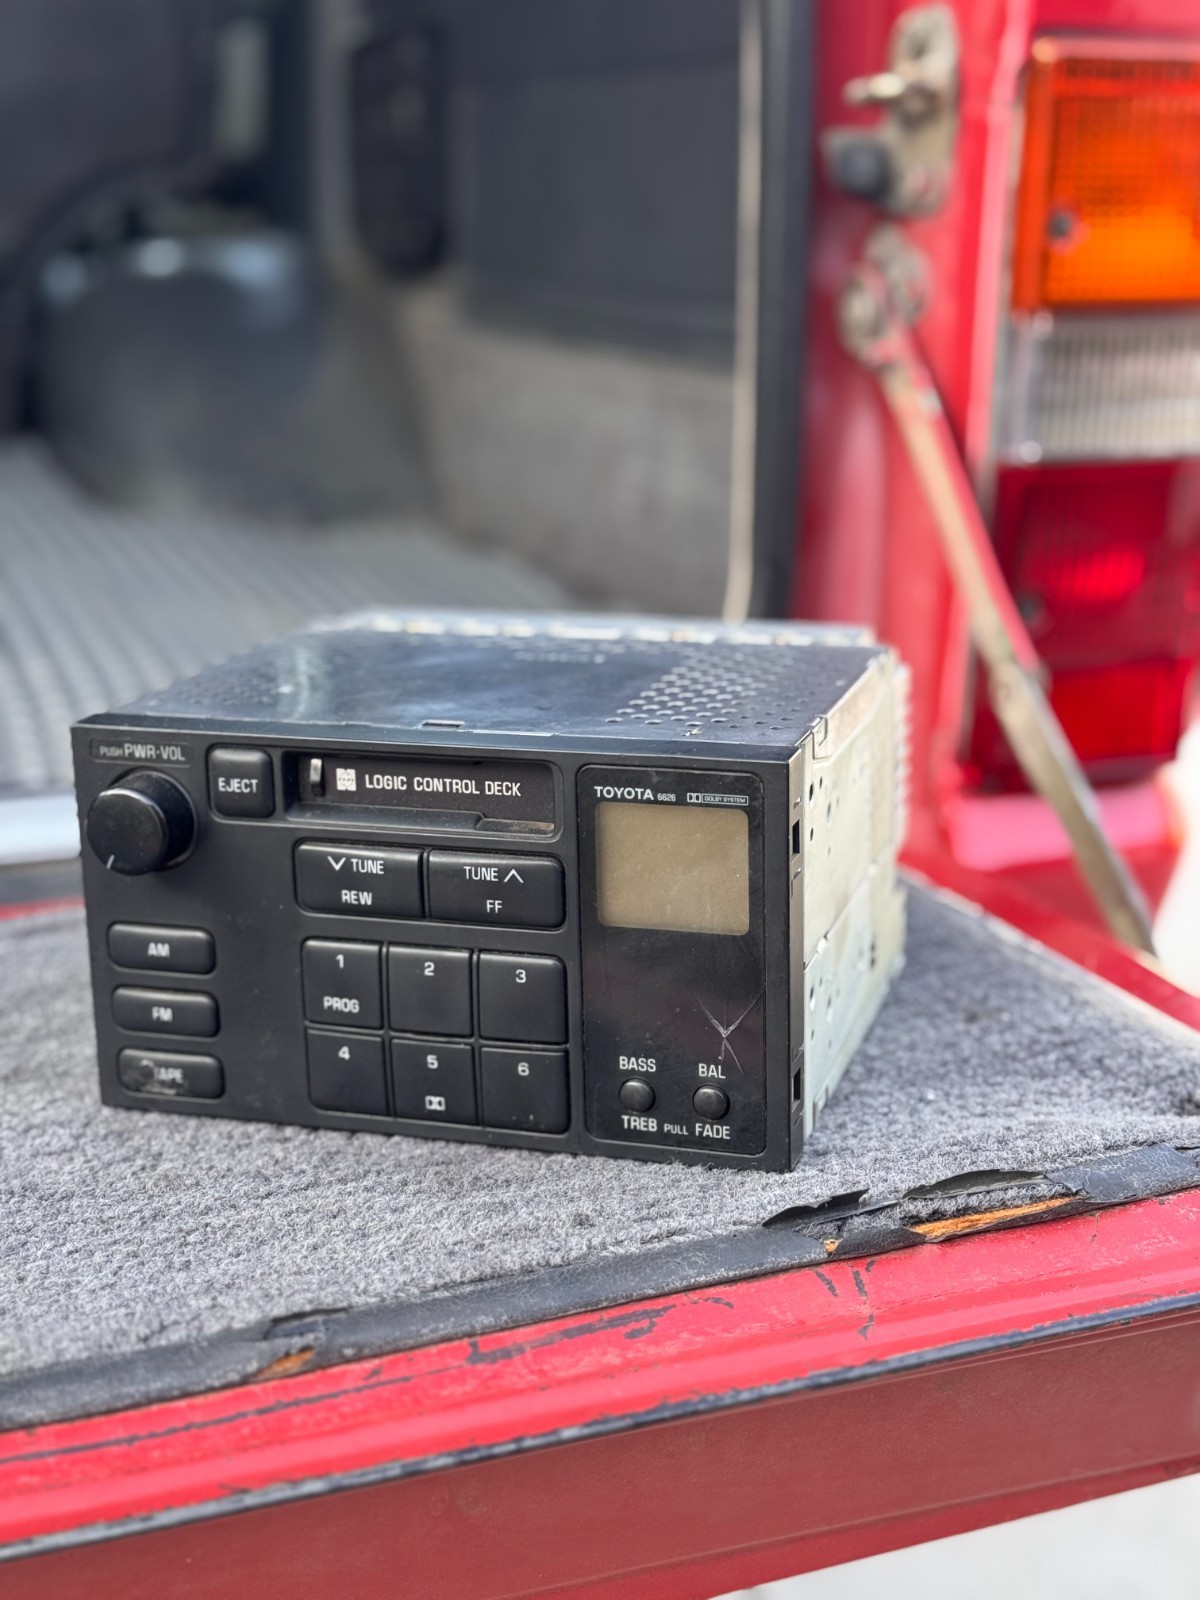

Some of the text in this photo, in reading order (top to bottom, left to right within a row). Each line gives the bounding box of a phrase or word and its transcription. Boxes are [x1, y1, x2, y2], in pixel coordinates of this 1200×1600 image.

[218, 777, 259, 793] EJECT
[365, 774, 521, 796] LOGIC CONTROL DECK
[594, 786, 654, 800] TOYOTA
[351, 858, 384, 874] TUNE
[463, 866, 499, 881] TUNE
[341, 890, 372, 906] REW
[486, 900, 503, 914] FF
[147, 942, 170, 957] AM
[335, 954, 345, 969] 1
[424, 962, 435, 976] 2
[515, 970, 527, 983] 3
[323, 996, 360, 1013] PROG
[152, 1006, 173, 1022] FM
[338, 1046, 350, 1060] 4
[427, 1055, 439, 1069] 5
[517, 1063, 530, 1076] 6
[619, 1056, 656, 1072] BASS
[698, 1063, 726, 1079] BAL
[621, 1115, 731, 1140] TREB PULL FADE
